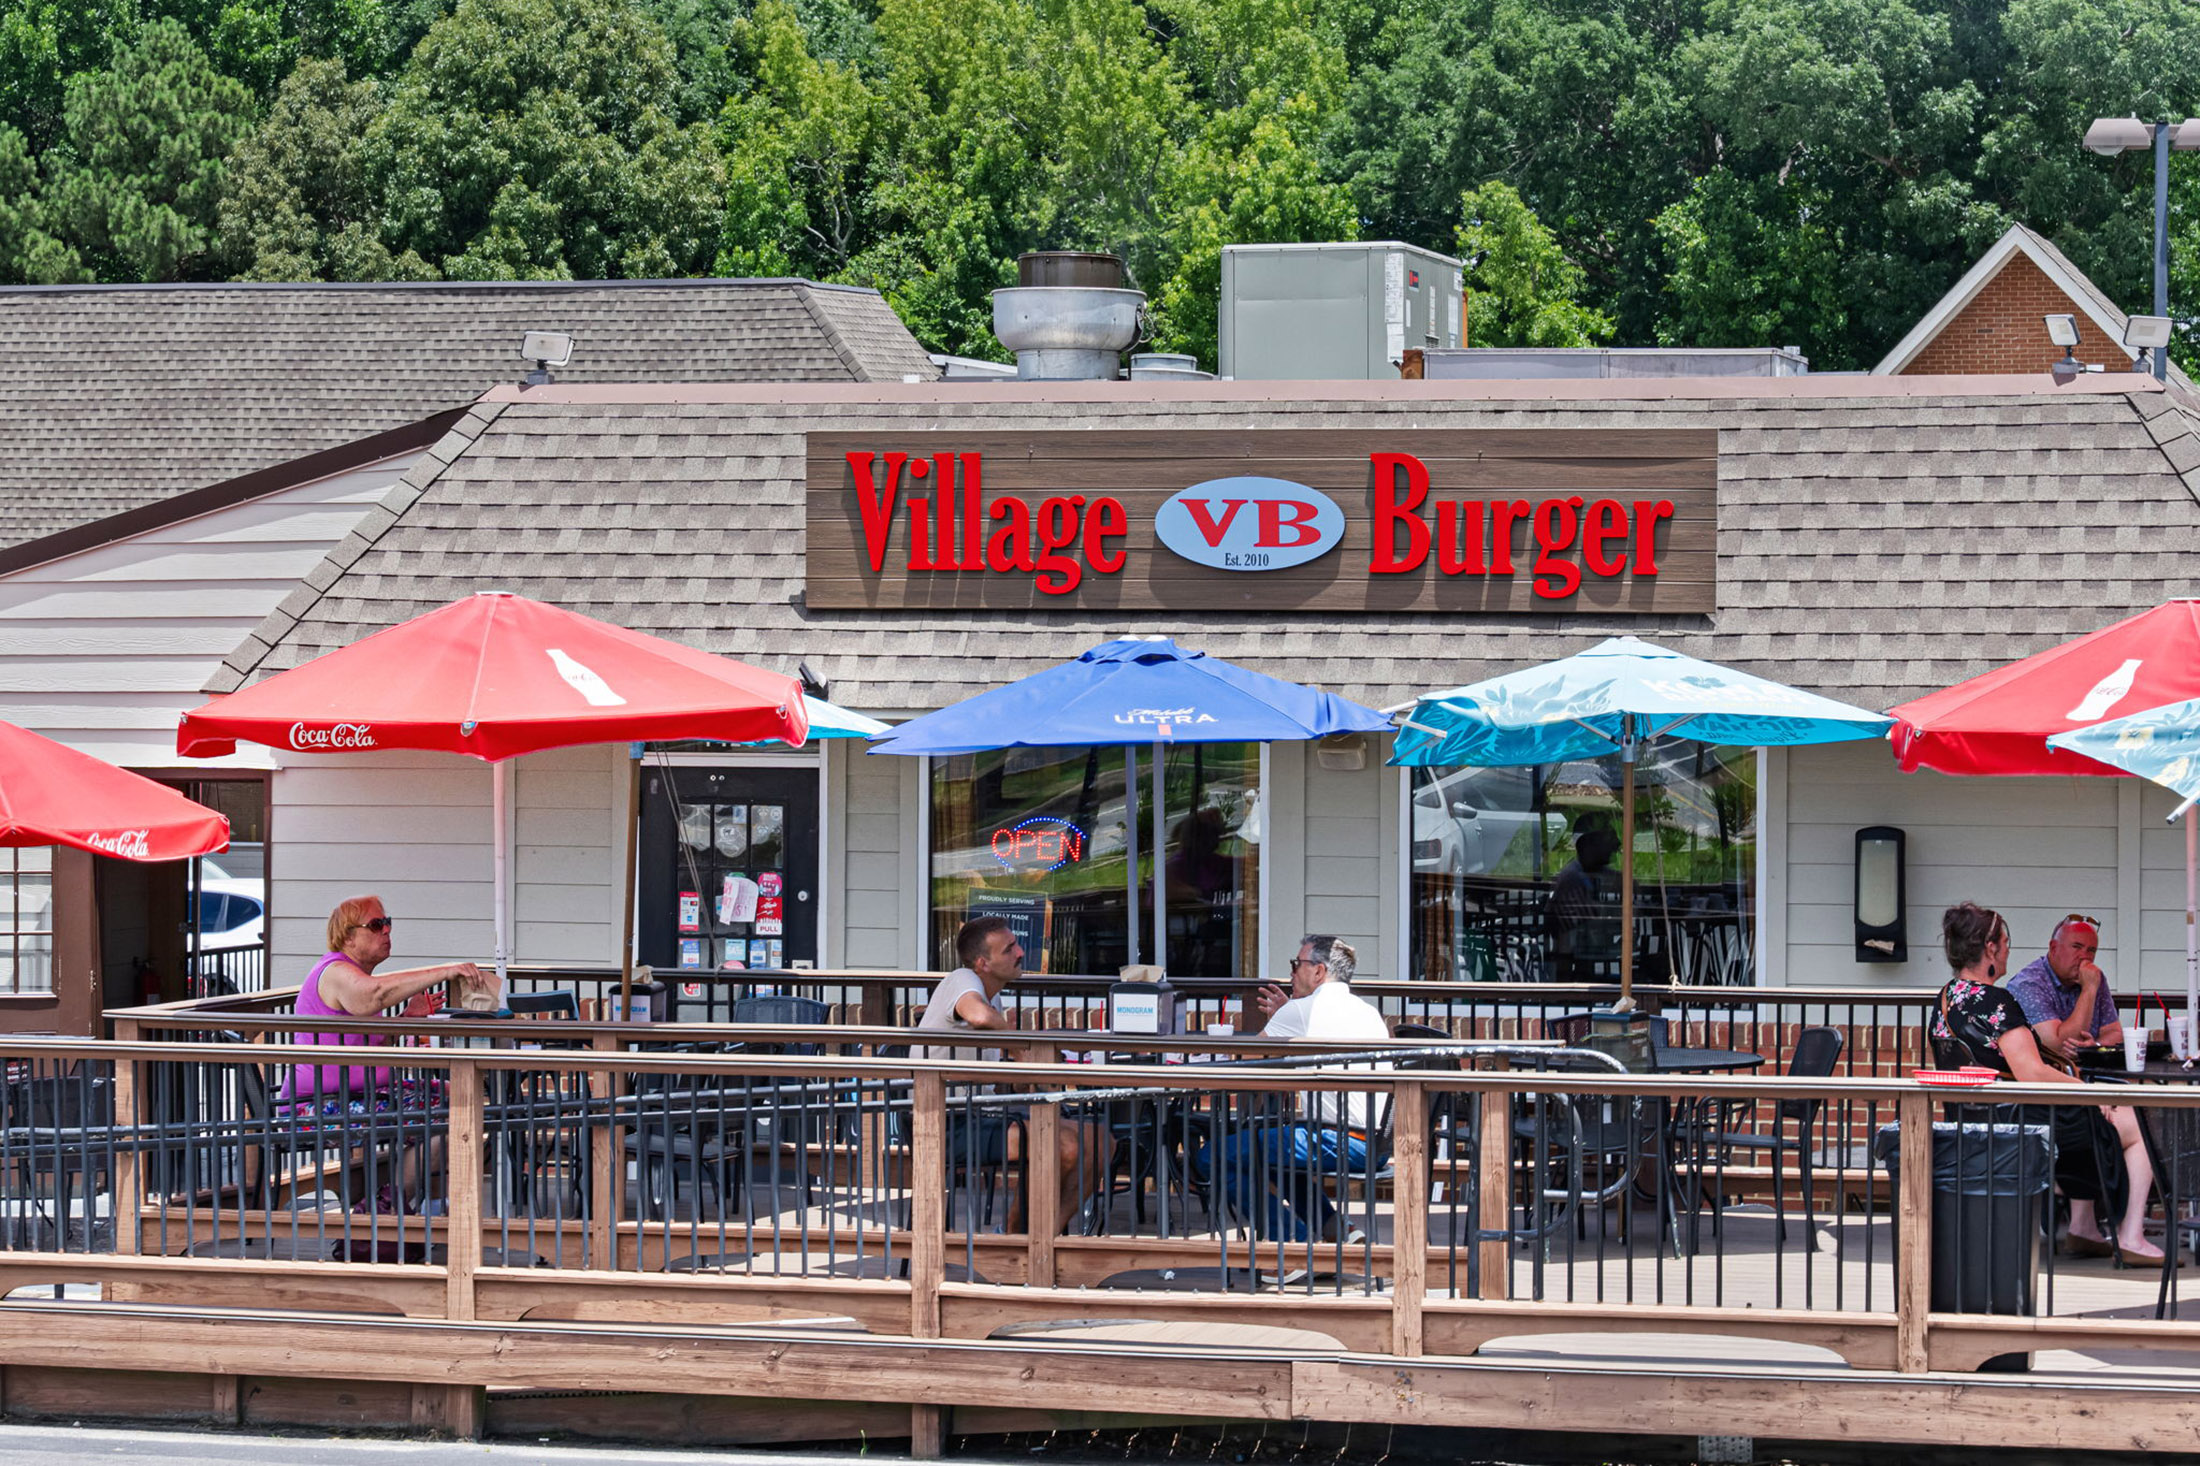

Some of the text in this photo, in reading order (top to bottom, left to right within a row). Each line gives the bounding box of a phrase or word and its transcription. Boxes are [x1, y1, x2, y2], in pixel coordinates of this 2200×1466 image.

[846, 452, 1674, 599] Village VB Burger
[1225, 552, 1269, 567] Est. 2010
[1114, 713, 1219, 724] ULTRA
[289, 722, 376, 750] Coca-Cola
[991, 829, 1081, 862] OPEN
[979, 894, 1035, 905] PROUDLY SERVING
[1011, 913, 1029, 921] MADE
[1116, 1006, 1154, 1014] MONOGRAM
